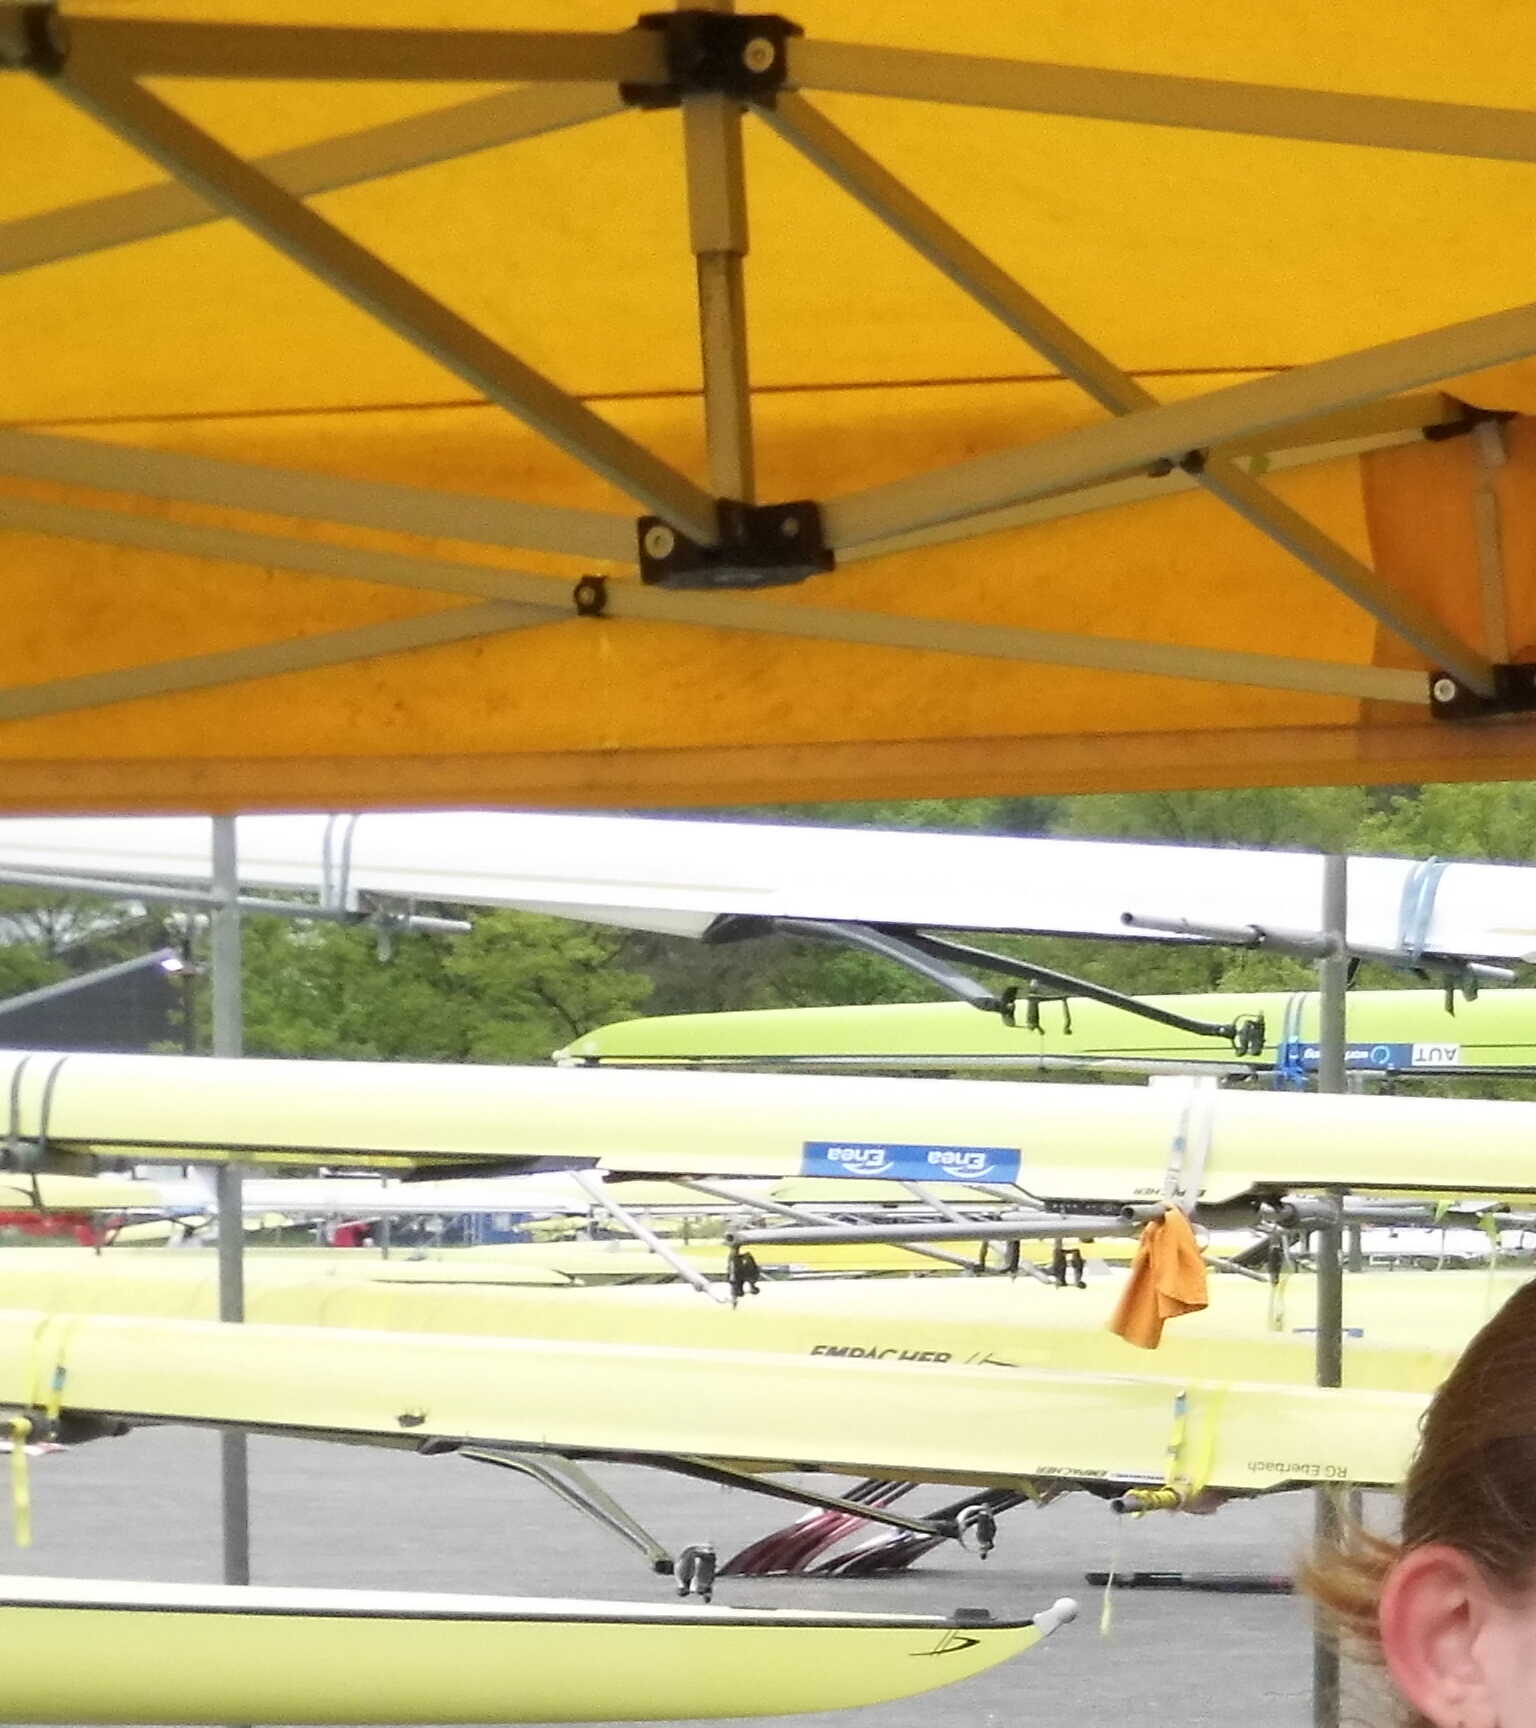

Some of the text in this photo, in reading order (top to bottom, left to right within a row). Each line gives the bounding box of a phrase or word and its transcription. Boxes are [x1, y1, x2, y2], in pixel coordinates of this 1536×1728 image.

[1415, 1047, 1457, 1062] AUT
[827, 1147, 986, 1170] Enea Enea
[1247, 1460, 1348, 1478] RG Eberbach
